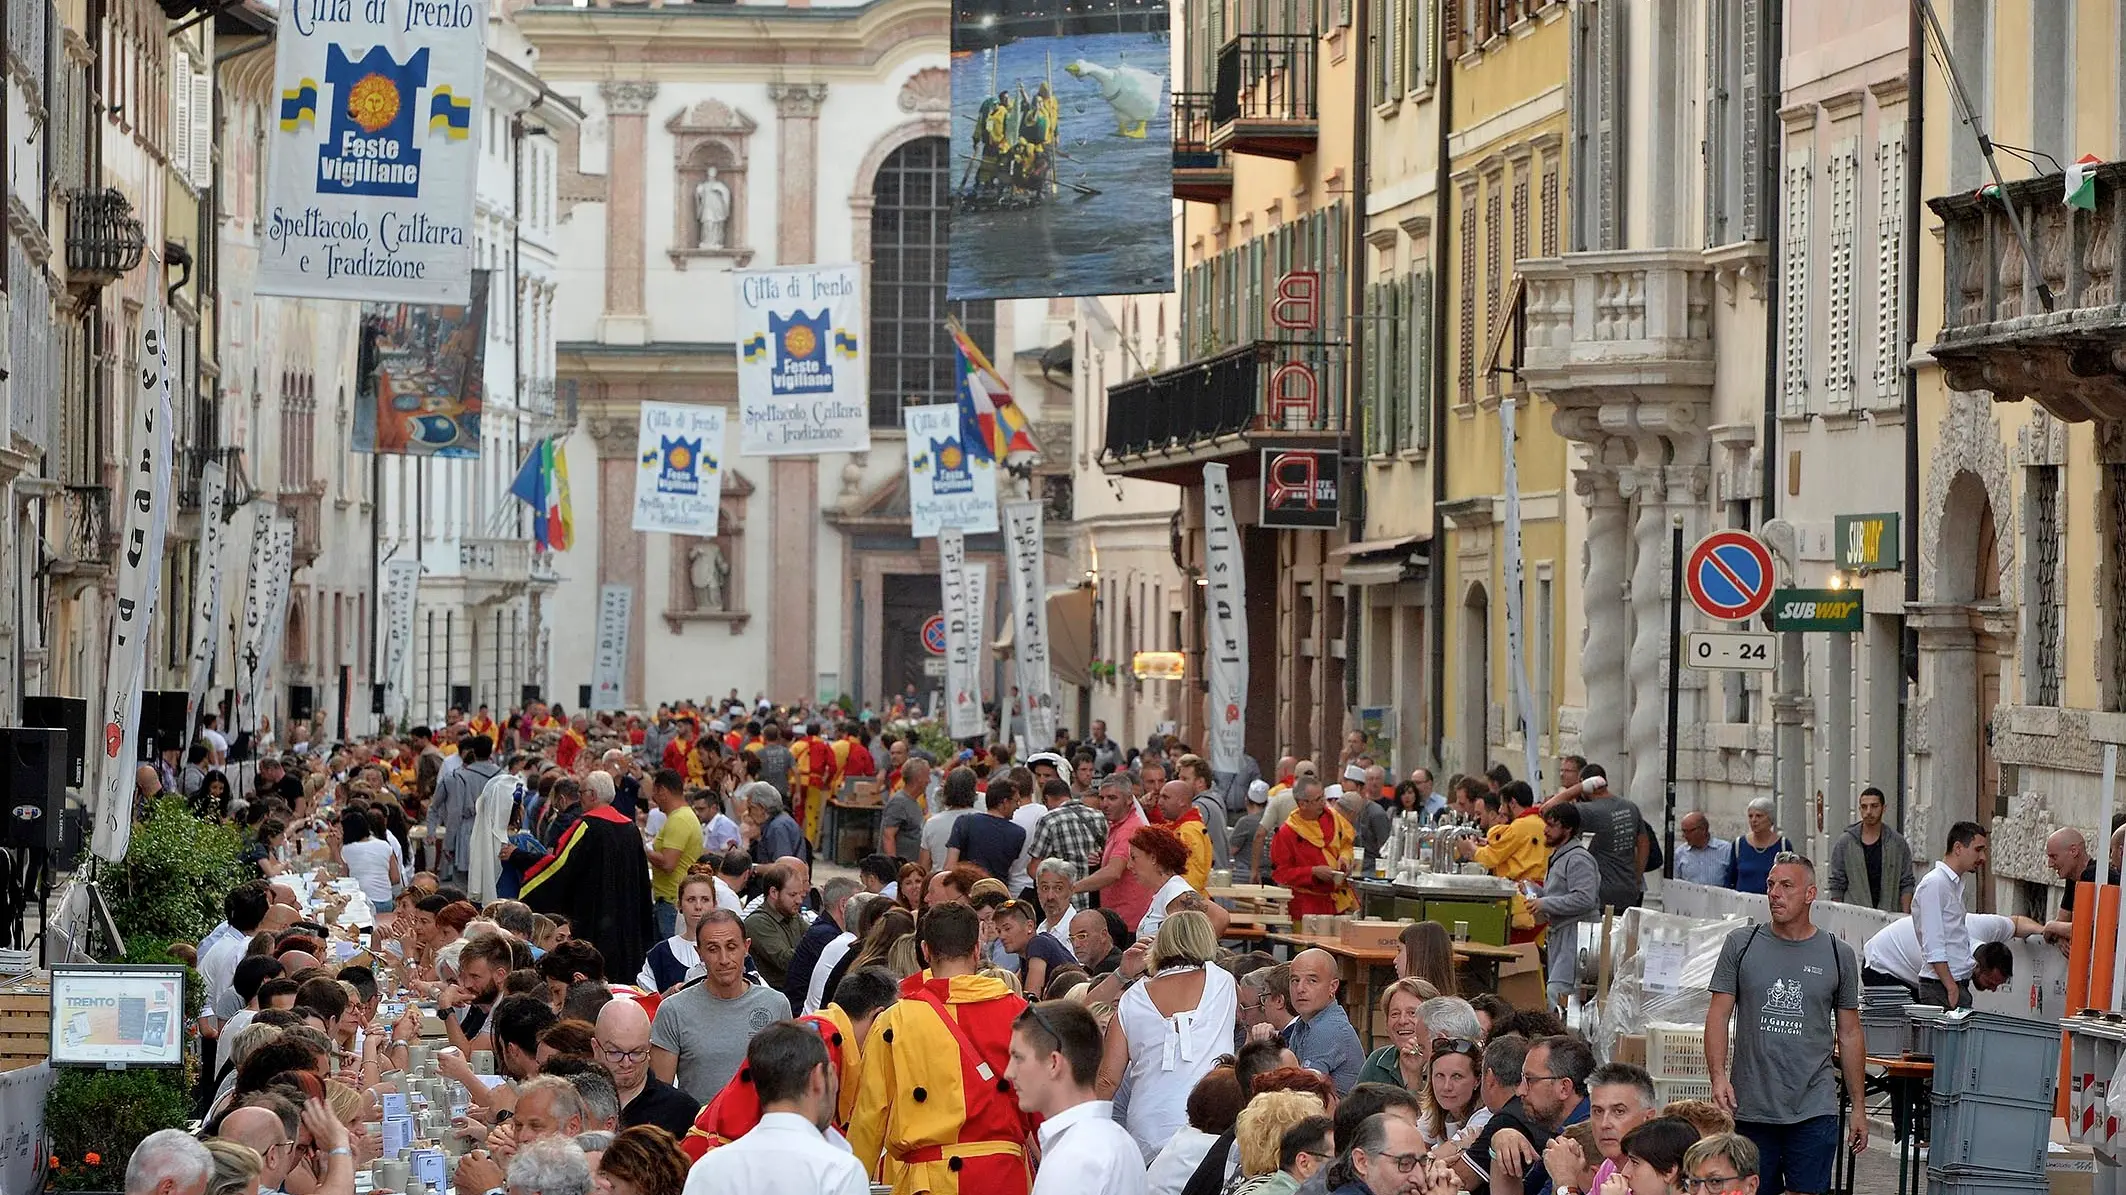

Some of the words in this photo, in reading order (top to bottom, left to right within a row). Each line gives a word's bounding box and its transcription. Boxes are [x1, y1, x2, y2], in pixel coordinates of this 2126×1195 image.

[365, 0, 386, 25] di
[341, 130, 400, 160] Feste
[321, 156, 418, 187] Vigiliane
[379, 211, 463, 253] Cultura
[299, 255, 310, 273] e
[322, 243, 425, 280] Tradizione
[743, 276, 780, 308] Città
[787, 275, 801, 297] di
[808, 272, 853, 300] Trento
[784, 358, 820, 375] Feste
[773, 372, 832, 390] Vigiliane
[766, 431, 773, 442] e
[779, 421, 845, 444] Tradizione
[1847, 519, 1884, 564] SUBWAY
[1778, 601, 1858, 620] SUBWAY
[1221, 638, 1240, 664] la
[1739, 644, 1767, 660] 24
[65, 997, 115, 1008] TRENTO
